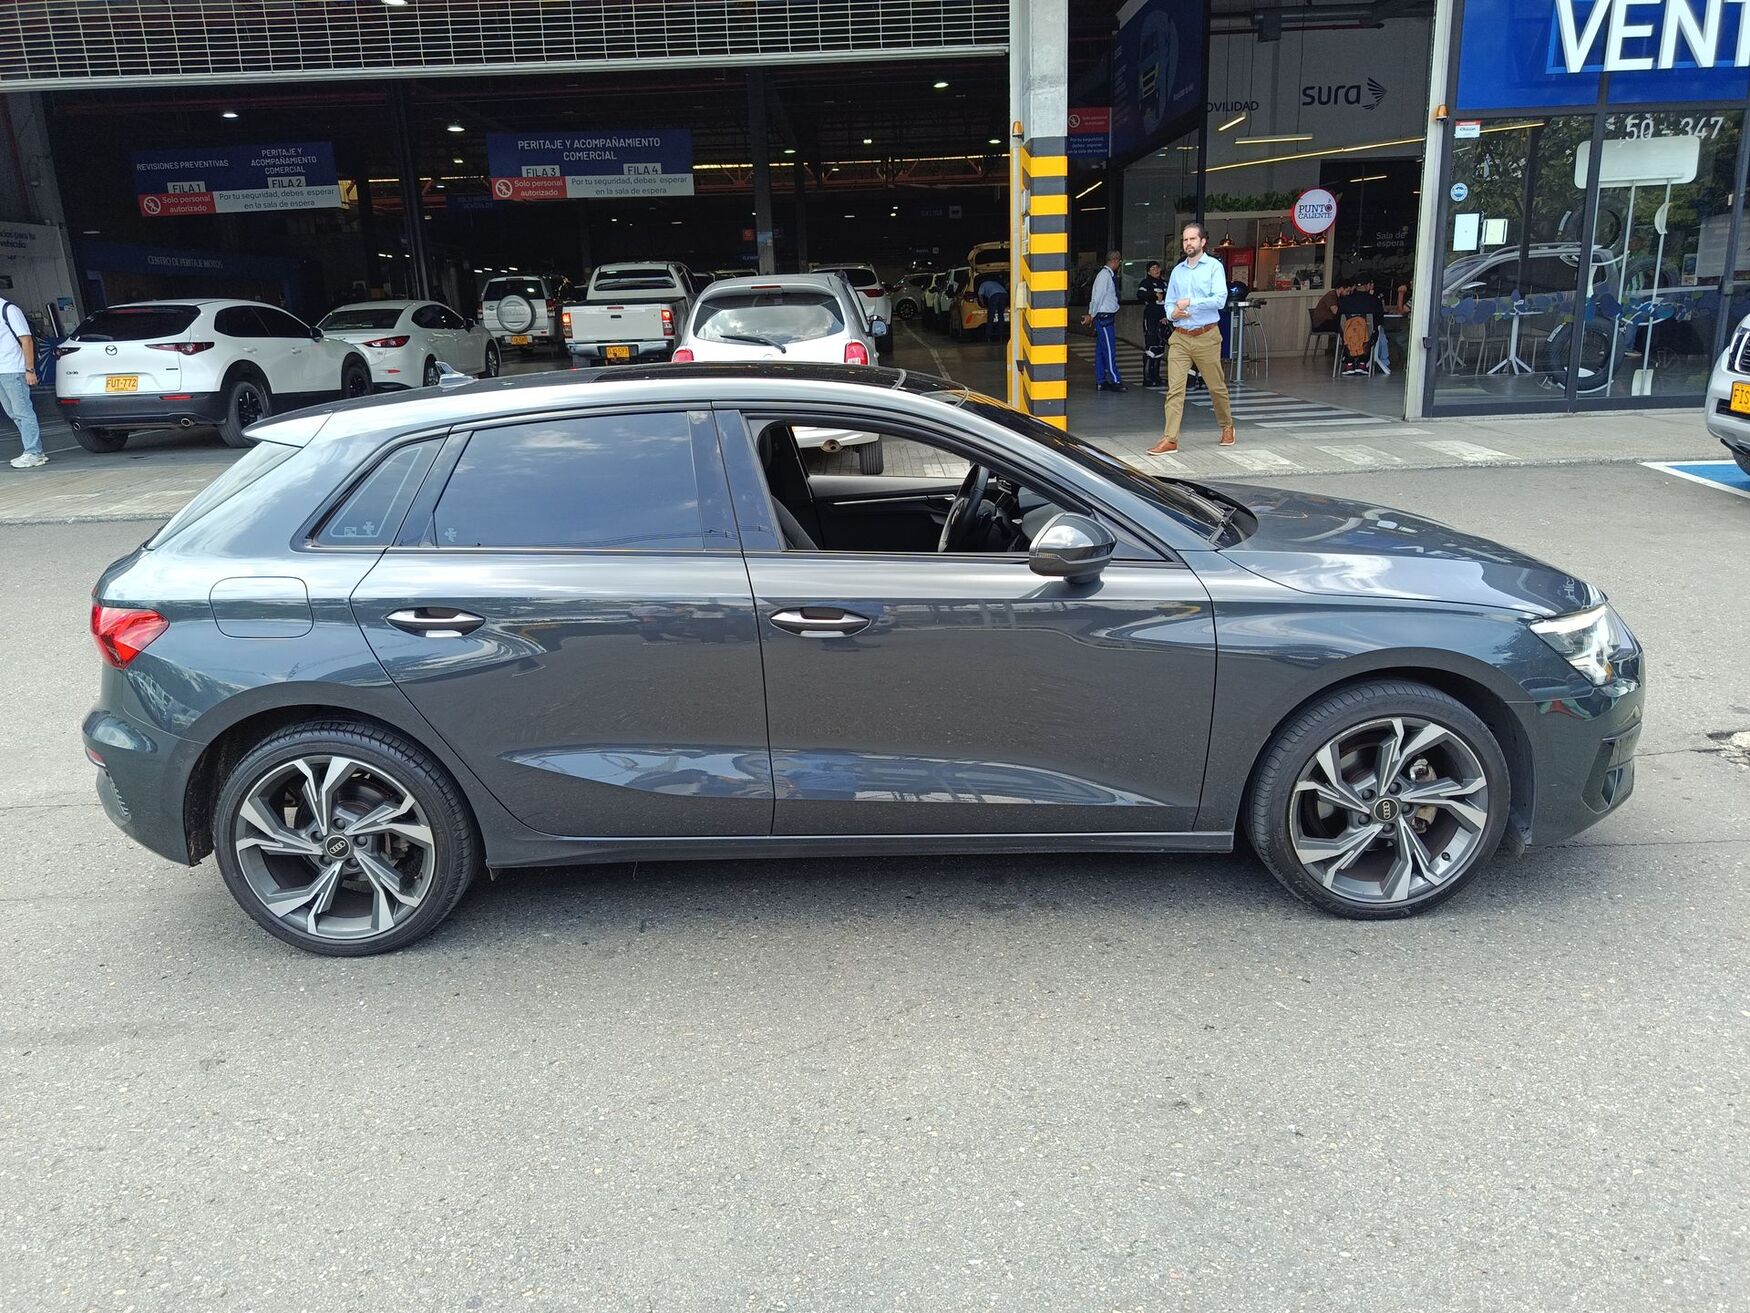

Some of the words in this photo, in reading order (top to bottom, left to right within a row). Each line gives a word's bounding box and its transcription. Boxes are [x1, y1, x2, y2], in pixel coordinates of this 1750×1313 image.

[1302, 85, 1361, 106] sura
[1206, 101, 1259, 112] OVILIDAD
[518, 140, 563, 150] PERITAJE
[566, 139, 571, 148] Y
[574, 137, 661, 148] ACOMPAÑAMIENTO
[261, 149, 297, 157] PERITAJE
[563, 151, 617, 161] COMERCIAL
[136, 162, 179, 171] REVISIONES
[180, 160, 229, 169] PREVENTIVAS
[265, 166, 306, 174] COMERCIAL
[627, 166, 650, 175] FILA
[652, 165, 658, 174] 4
[526, 168, 549, 177] FILA
[550, 167, 556, 176] 3
[272, 179, 293, 188] FILA
[296, 178, 302, 187] 2
[532, 179, 563, 188] personal
[571, 178, 584, 186] Por
[659, 174, 688, 184] esperar
[172, 184, 194, 193] FILA
[520, 189, 559, 197] autorizado
[614, 187, 630, 195] sala
[642, 186, 667, 195] espera
[162, 196, 179, 204] Solo
[179, 195, 211, 204] personal
[219, 193, 231, 201] Por
[307, 188, 334, 197] esperar
[263, 200, 278, 208] sala
[279, 200, 289, 208] de
[290, 200, 315, 208] espera
[1299, 203, 1332, 213] PUNTO
[1376, 231, 1393, 240] Sala
